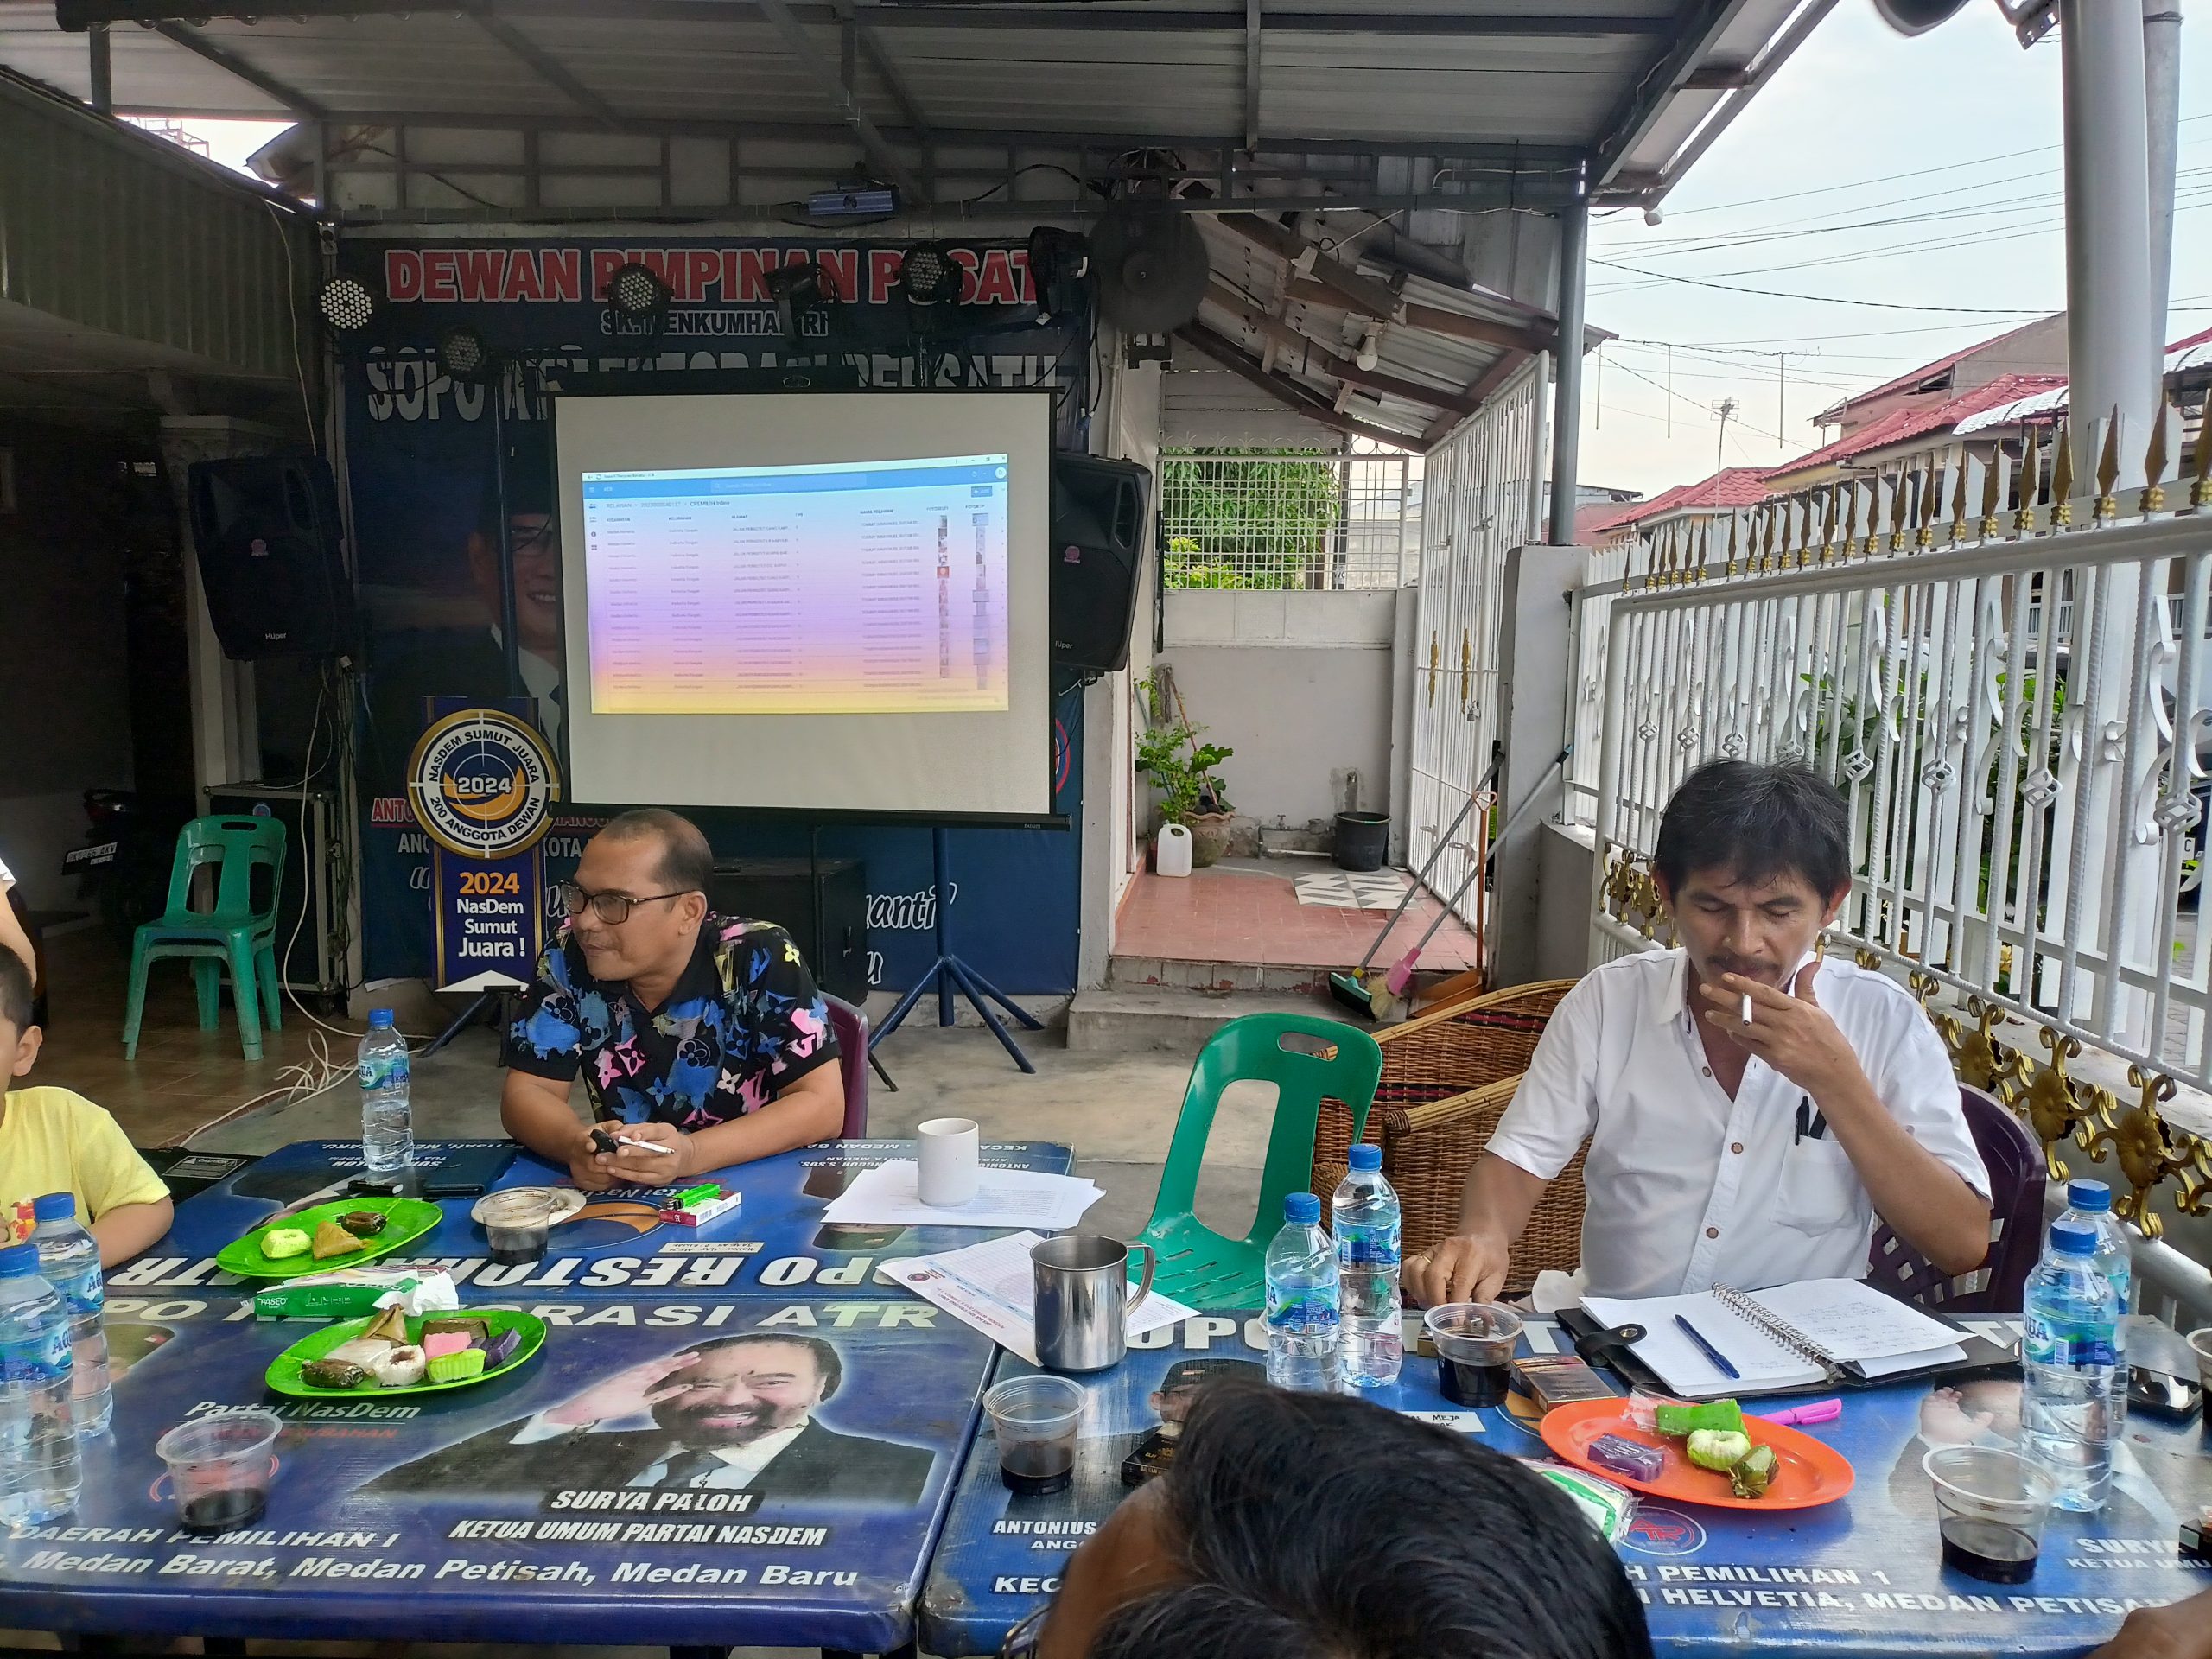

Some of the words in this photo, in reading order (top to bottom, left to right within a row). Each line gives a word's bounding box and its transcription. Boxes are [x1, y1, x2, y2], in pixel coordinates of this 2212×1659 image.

[385, 249, 582, 302] DEWAN
[590, 249, 860, 303] PMPINN
[868, 249, 1039, 304] PSAT
[429, 735, 462, 782] NASDEM
[464, 730, 512, 745] SUMUT
[512, 745, 540, 783] JUARA
[457, 776, 512, 794] 2024
[430, 797, 448, 818] 200
[445, 818, 507, 841] ANGGOTA
[507, 797, 540, 835] DEWAN
[459, 872, 520, 894] 2024
[457, 899, 524, 914] NasDem
[464, 918, 518, 935] Sumut
[458, 938, 515, 957] Juara
[520, 938, 525, 957] !
[758, 1256, 914, 1286] PO
[260, 1297, 288, 1308] PASEO
[103, 1300, 207, 1321] PO
[754, 1305, 939, 1328] ATR
[287, 1402, 422, 1419] NasDem
[551, 1491, 651, 1510] SURYA
[653, 1492, 753, 1512] PALOH
[8, 1525, 164, 1543] DAERAH
[166, 1530, 377, 1548] PEMILIHAN
[448, 1520, 534, 1539] KETUA
[535, 1521, 622, 1541] UMUM
[620, 1523, 716, 1543] PARTAI
[715, 1525, 827, 1546] NASDEM
[993, 1520, 1096, 1535] ANTONIUS
[21, 1550, 154, 1573] Medan
[158, 1554, 278, 1580] Barat,
[289, 1557, 427, 1580] Medan
[434, 1560, 596, 1587] Petisah,
[610, 1562, 747, 1584] Medan
[760, 1565, 858, 1586] Baru
[2066, 1558, 2150, 1569] KETUA
[2158, 1559, 2212, 1570] UMU
[1656, 1565, 1861, 1585] PEMILIHAN
[1661, 1588, 1856, 1611] HELVETIA,
[1861, 1593, 2003, 1612] MEDAN
[2007, 1596, 2171, 1614] PETIS
